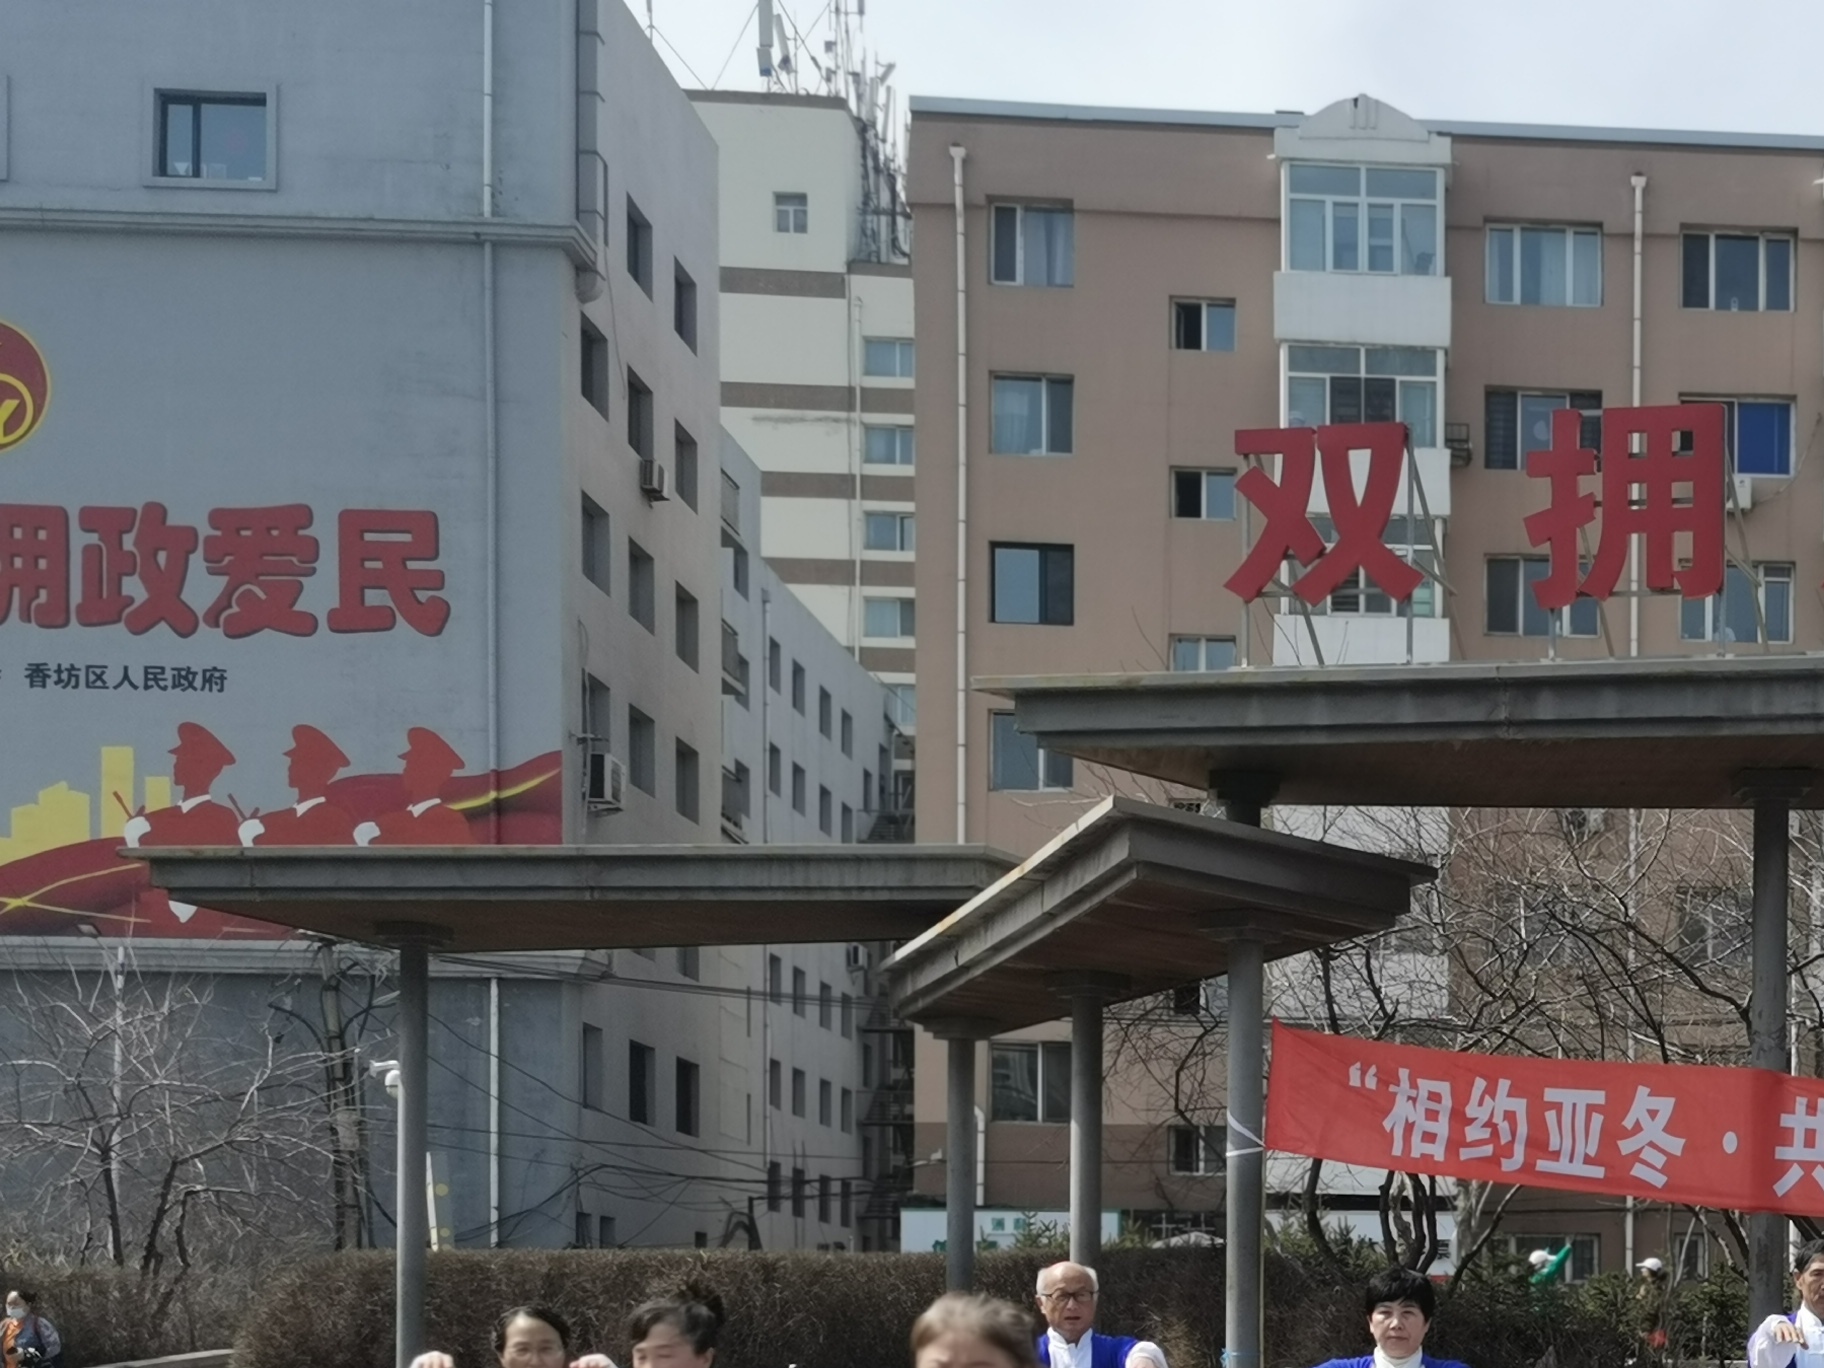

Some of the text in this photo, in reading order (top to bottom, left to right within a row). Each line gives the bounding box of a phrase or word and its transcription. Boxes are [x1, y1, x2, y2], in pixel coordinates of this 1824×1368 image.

[24, 662, 228, 693] 香坊区人民政府
